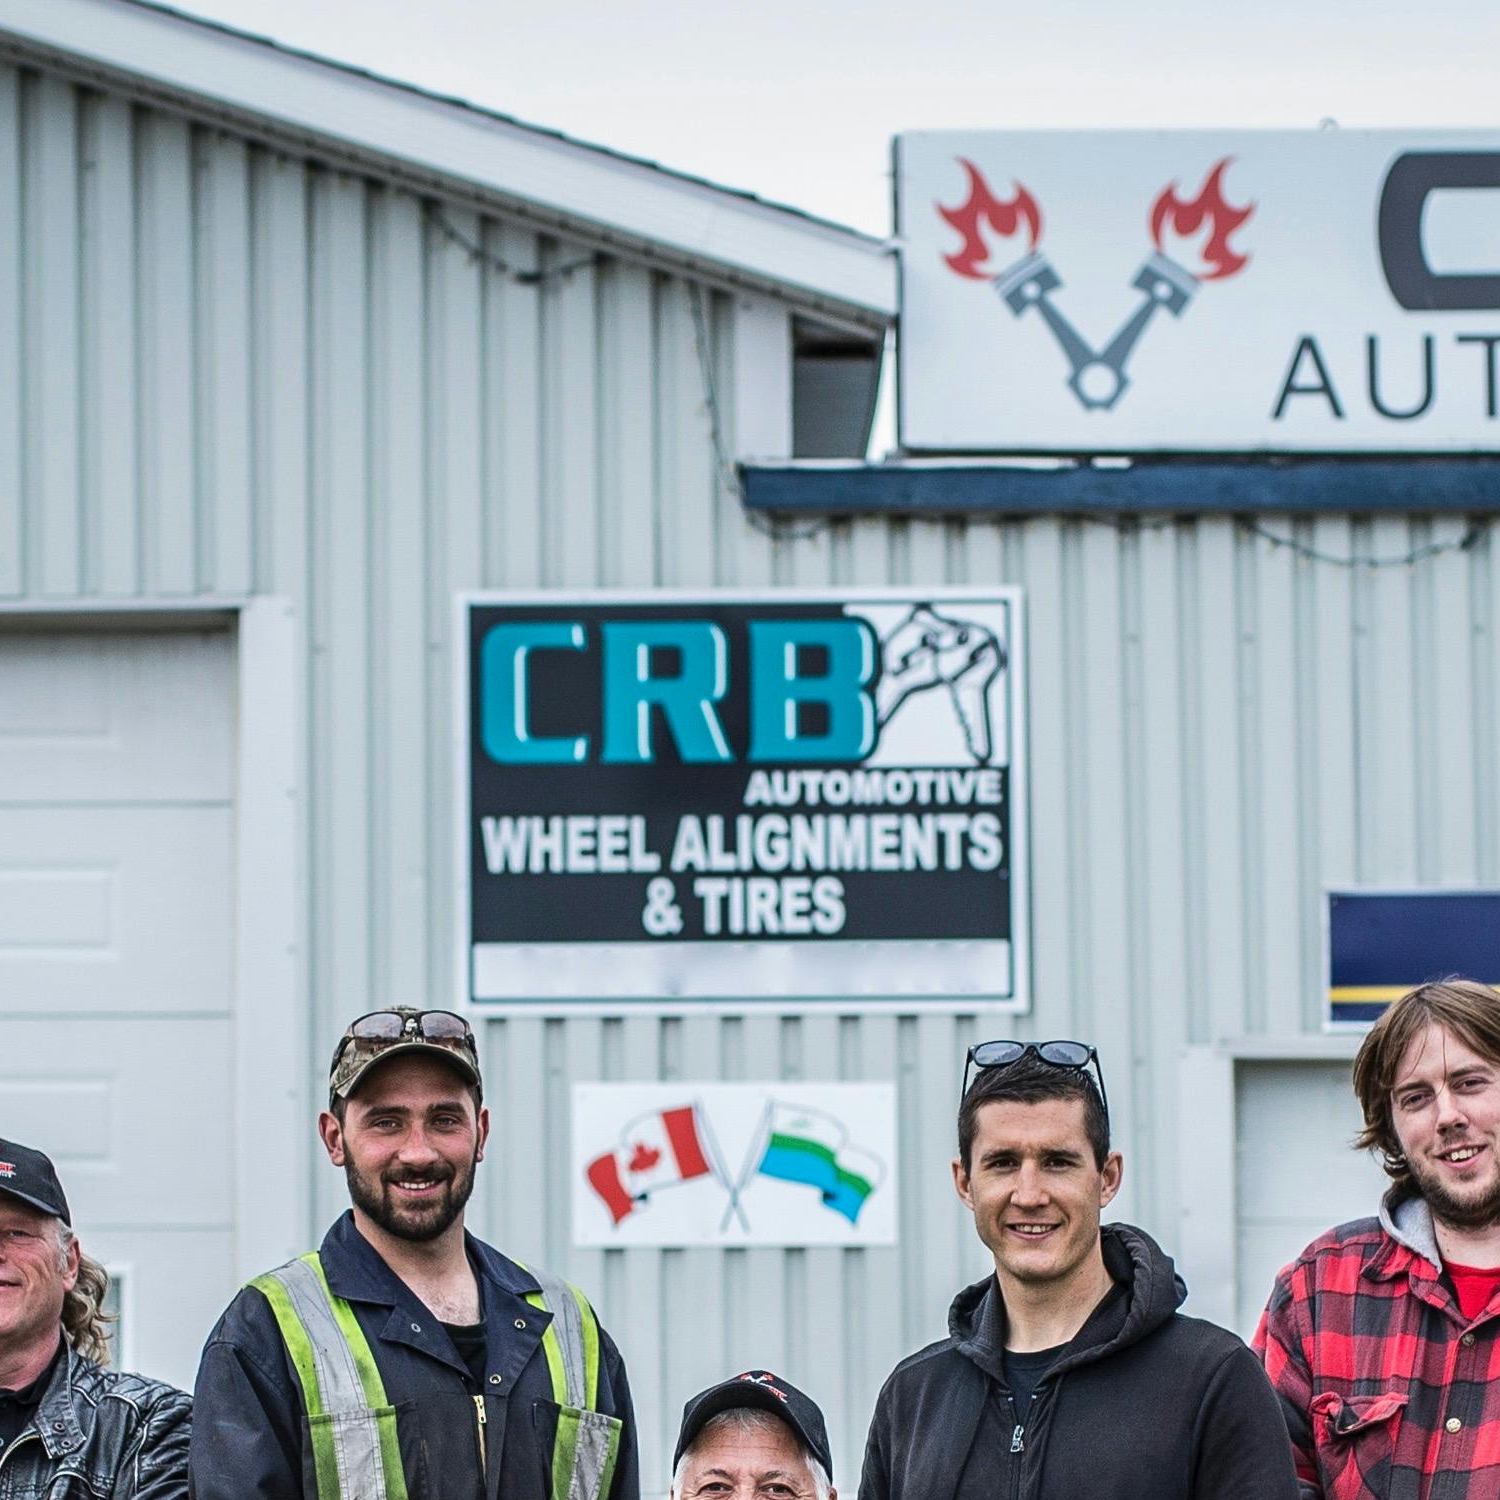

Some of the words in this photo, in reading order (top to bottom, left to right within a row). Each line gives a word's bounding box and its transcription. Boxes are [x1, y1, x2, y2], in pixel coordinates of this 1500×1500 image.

[480, 619, 876, 763] CRB
[743, 769, 1003, 806] AUTOMOTIVE
[481, 814, 661, 874] WHEEL
[669, 812, 1004, 873] ALIGNMENTS
[642, 876, 684, 935] &
[693, 876, 847, 935] TIRES
